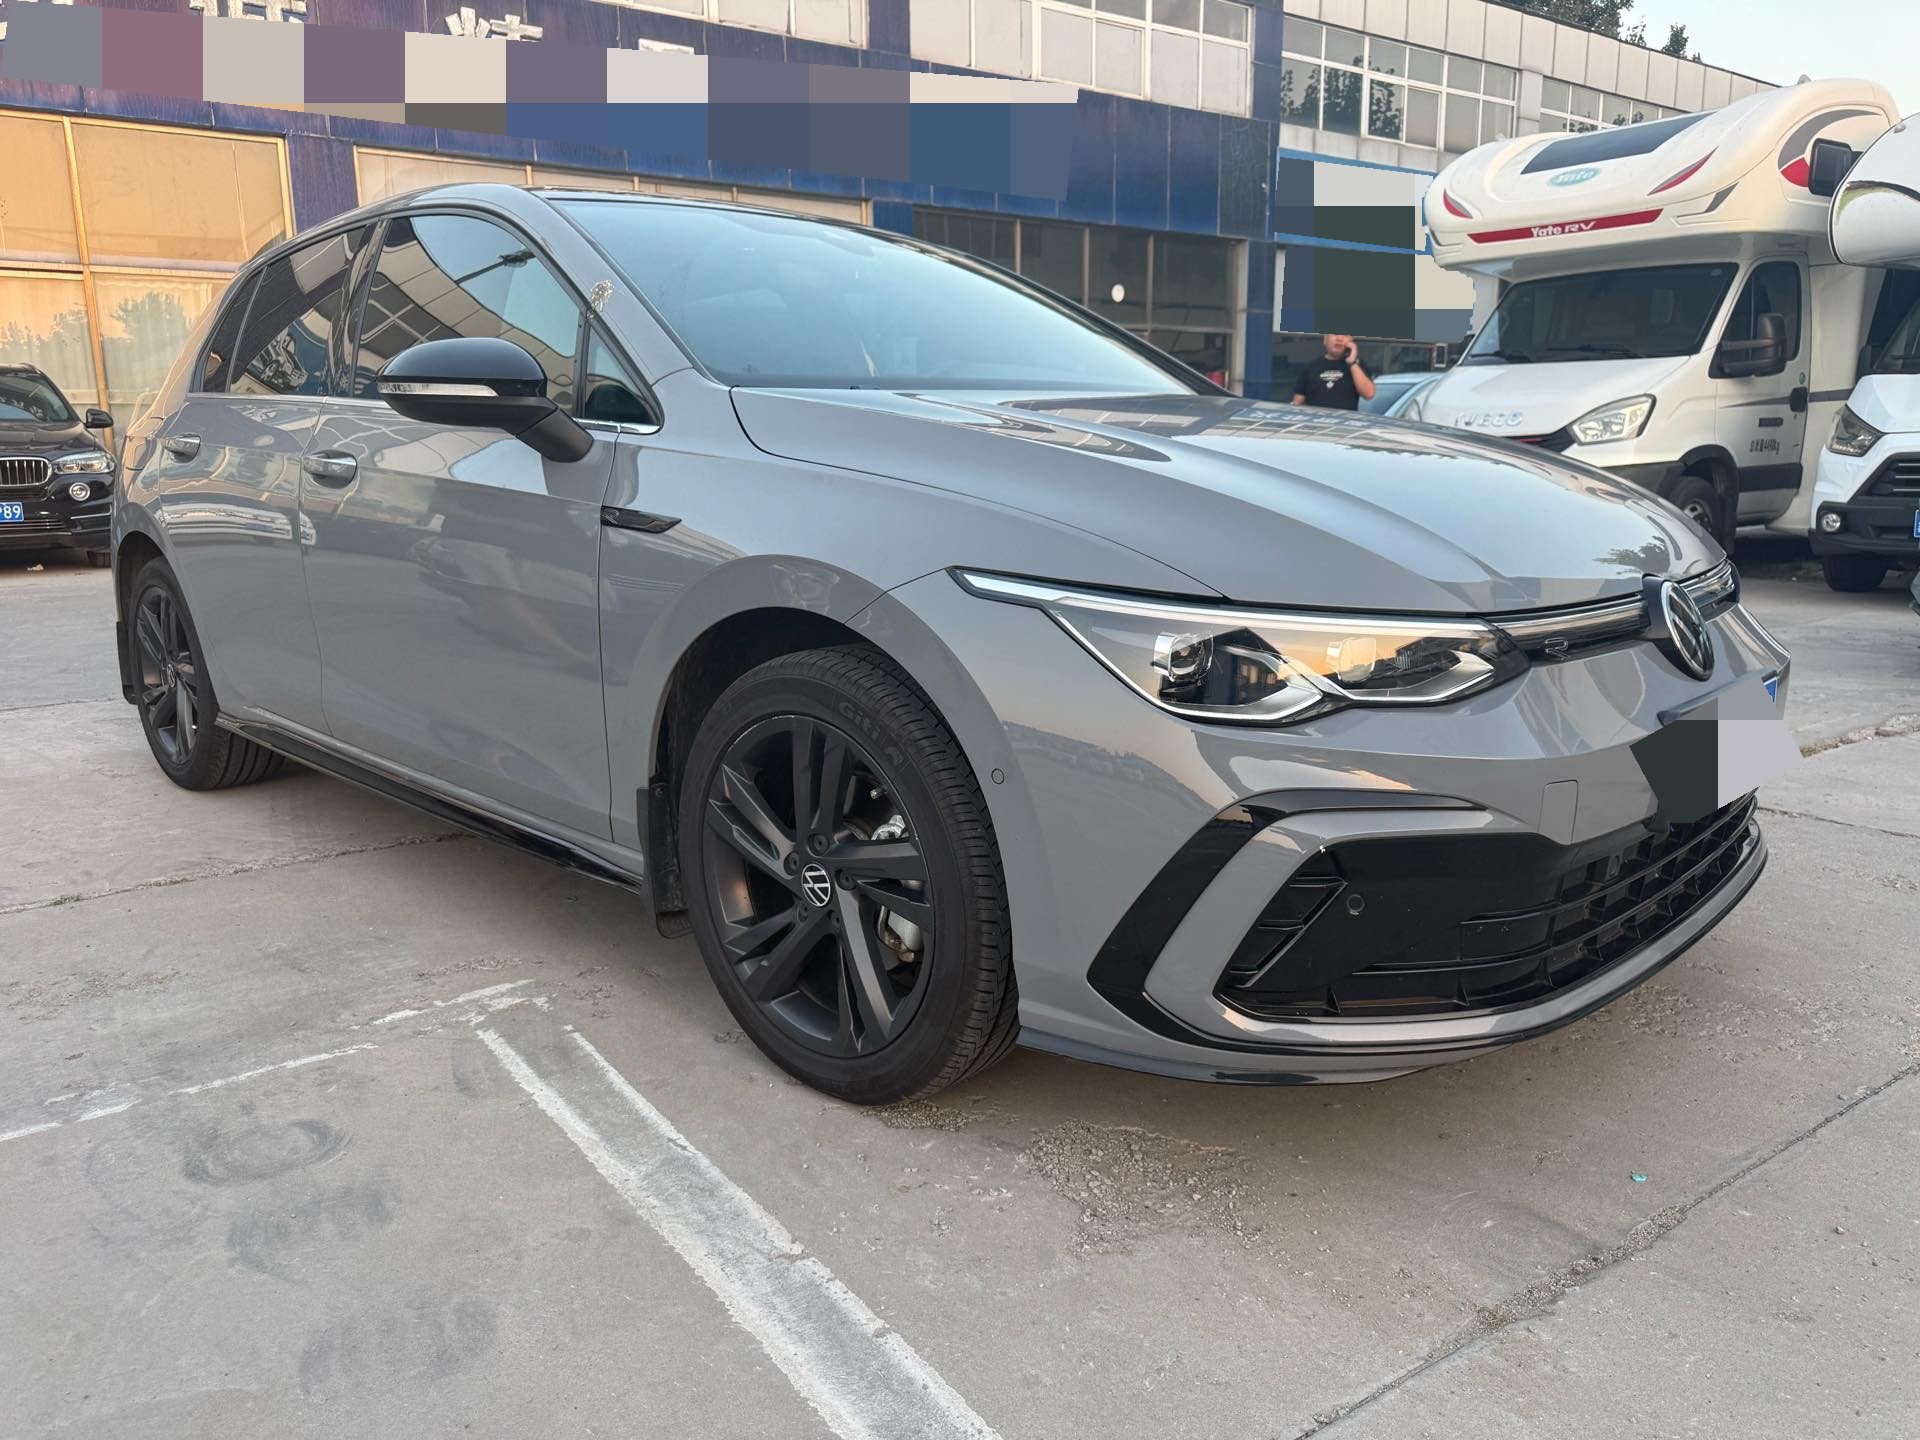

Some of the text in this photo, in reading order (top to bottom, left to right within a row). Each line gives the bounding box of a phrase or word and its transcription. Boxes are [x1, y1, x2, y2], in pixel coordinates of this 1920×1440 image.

[1531, 221, 1597, 238] Yate RV
[1454, 412, 1522, 427] IVECO
[840, 701, 881, 741] Giti
